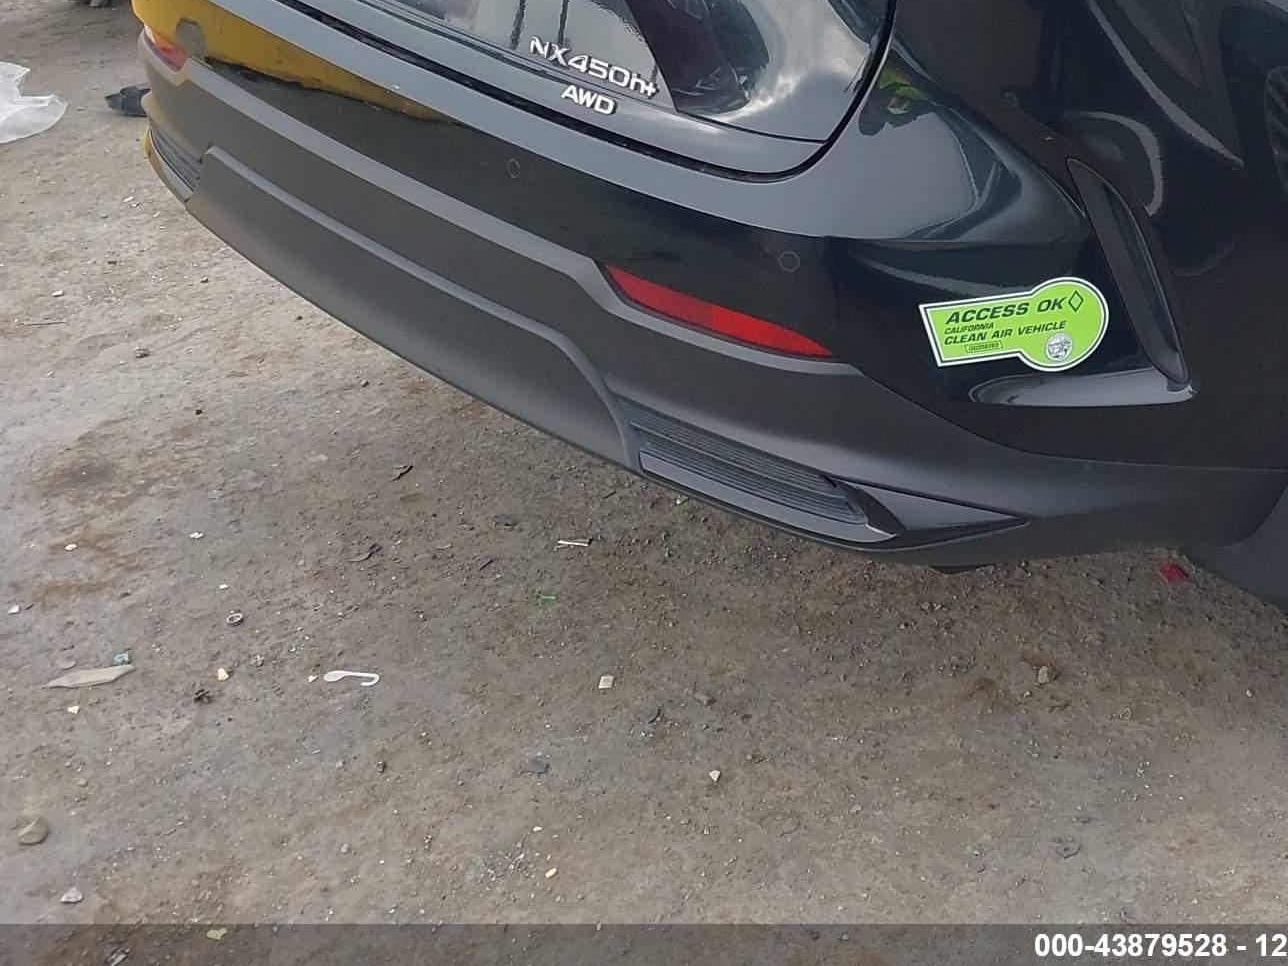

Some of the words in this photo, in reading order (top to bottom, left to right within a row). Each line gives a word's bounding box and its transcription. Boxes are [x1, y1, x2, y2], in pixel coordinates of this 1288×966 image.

[529, 36, 657, 97] NX450h+
[560, 84, 616, 115] AWD
[945, 302, 1030, 325] ACCESS
[1037, 296, 1068, 313] OK
[944, 322, 994, 335] CALIFORNIA
[944, 333, 987, 346] CLEAN
[991, 328, 1013, 339] AIR
[1017, 320, 1068, 336] VEHICLE
